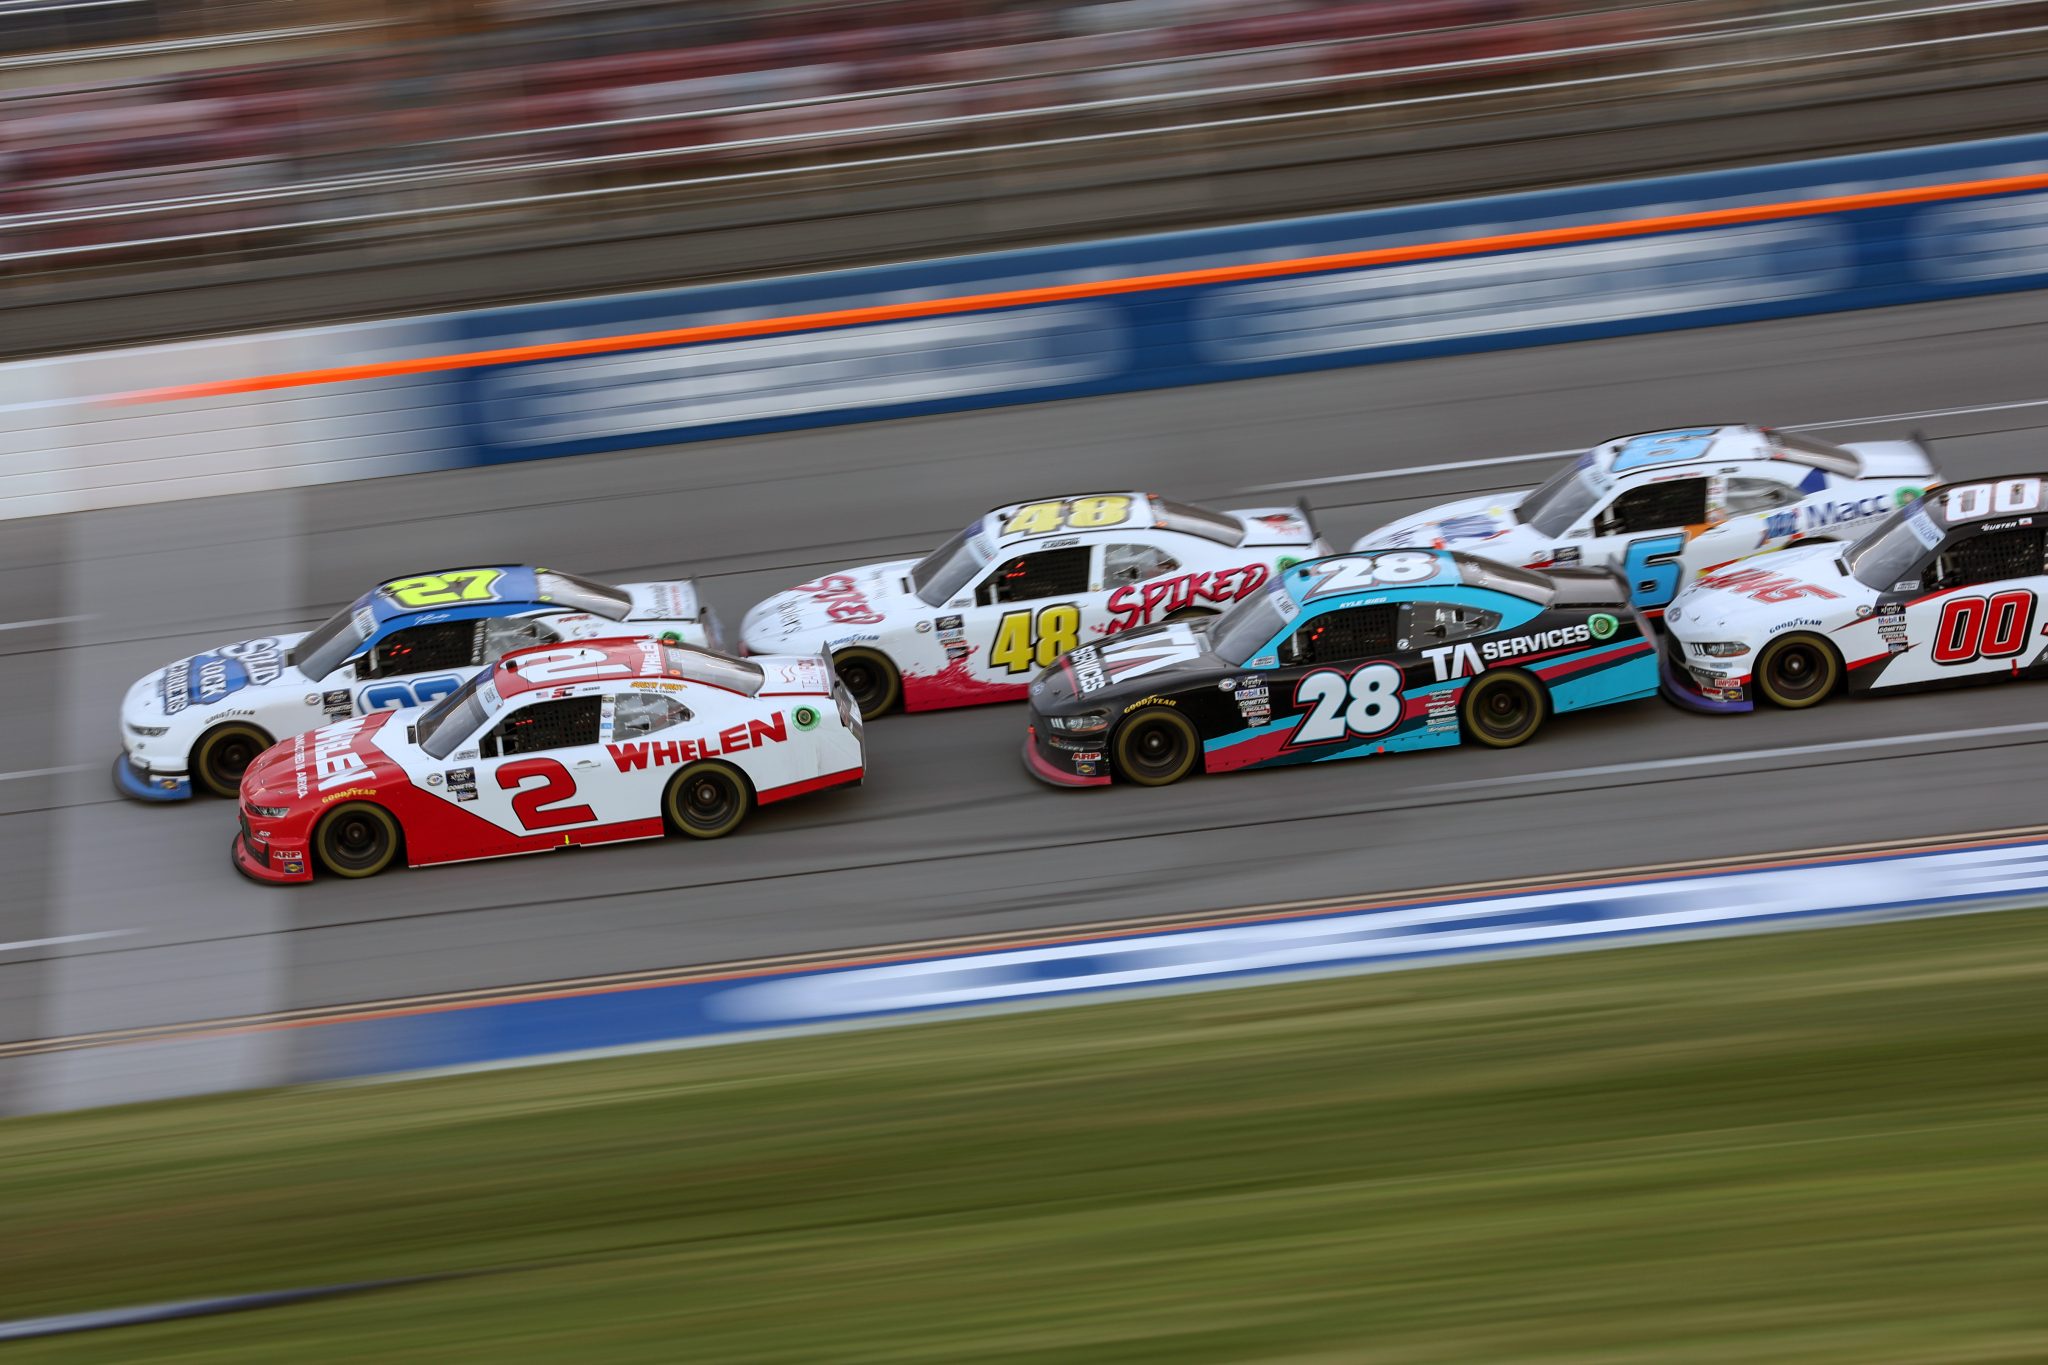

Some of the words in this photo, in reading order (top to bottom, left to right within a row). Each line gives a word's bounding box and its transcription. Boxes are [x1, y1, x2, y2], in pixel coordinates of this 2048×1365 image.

[1001, 495, 1133, 535] 48
[1945, 477, 2041, 521] 00
[383, 569, 500, 607] 27
[1305, 552, 1440, 596] 28
[1624, 532, 1684, 610] 6
[1107, 562, 1270, 634] SPIKED
[989, 603, 1079, 674] 48
[1769, 618, 1822, 634] GOODYEAR
[1930, 589, 2038, 667] 00
[1422, 643, 1485, 681] TA
[1483, 623, 1590, 661] SERVICES
[1123, 695, 1176, 714] GOODYEAR
[1240, 698, 1268, 707] COMETIC
[1280, 660, 1405, 750] 28
[605, 711, 788, 773] WHELEN
[321, 787, 377, 804] GOODYEAR
[495, 757, 598, 831] 2
[274, 851, 302, 859] ARP
